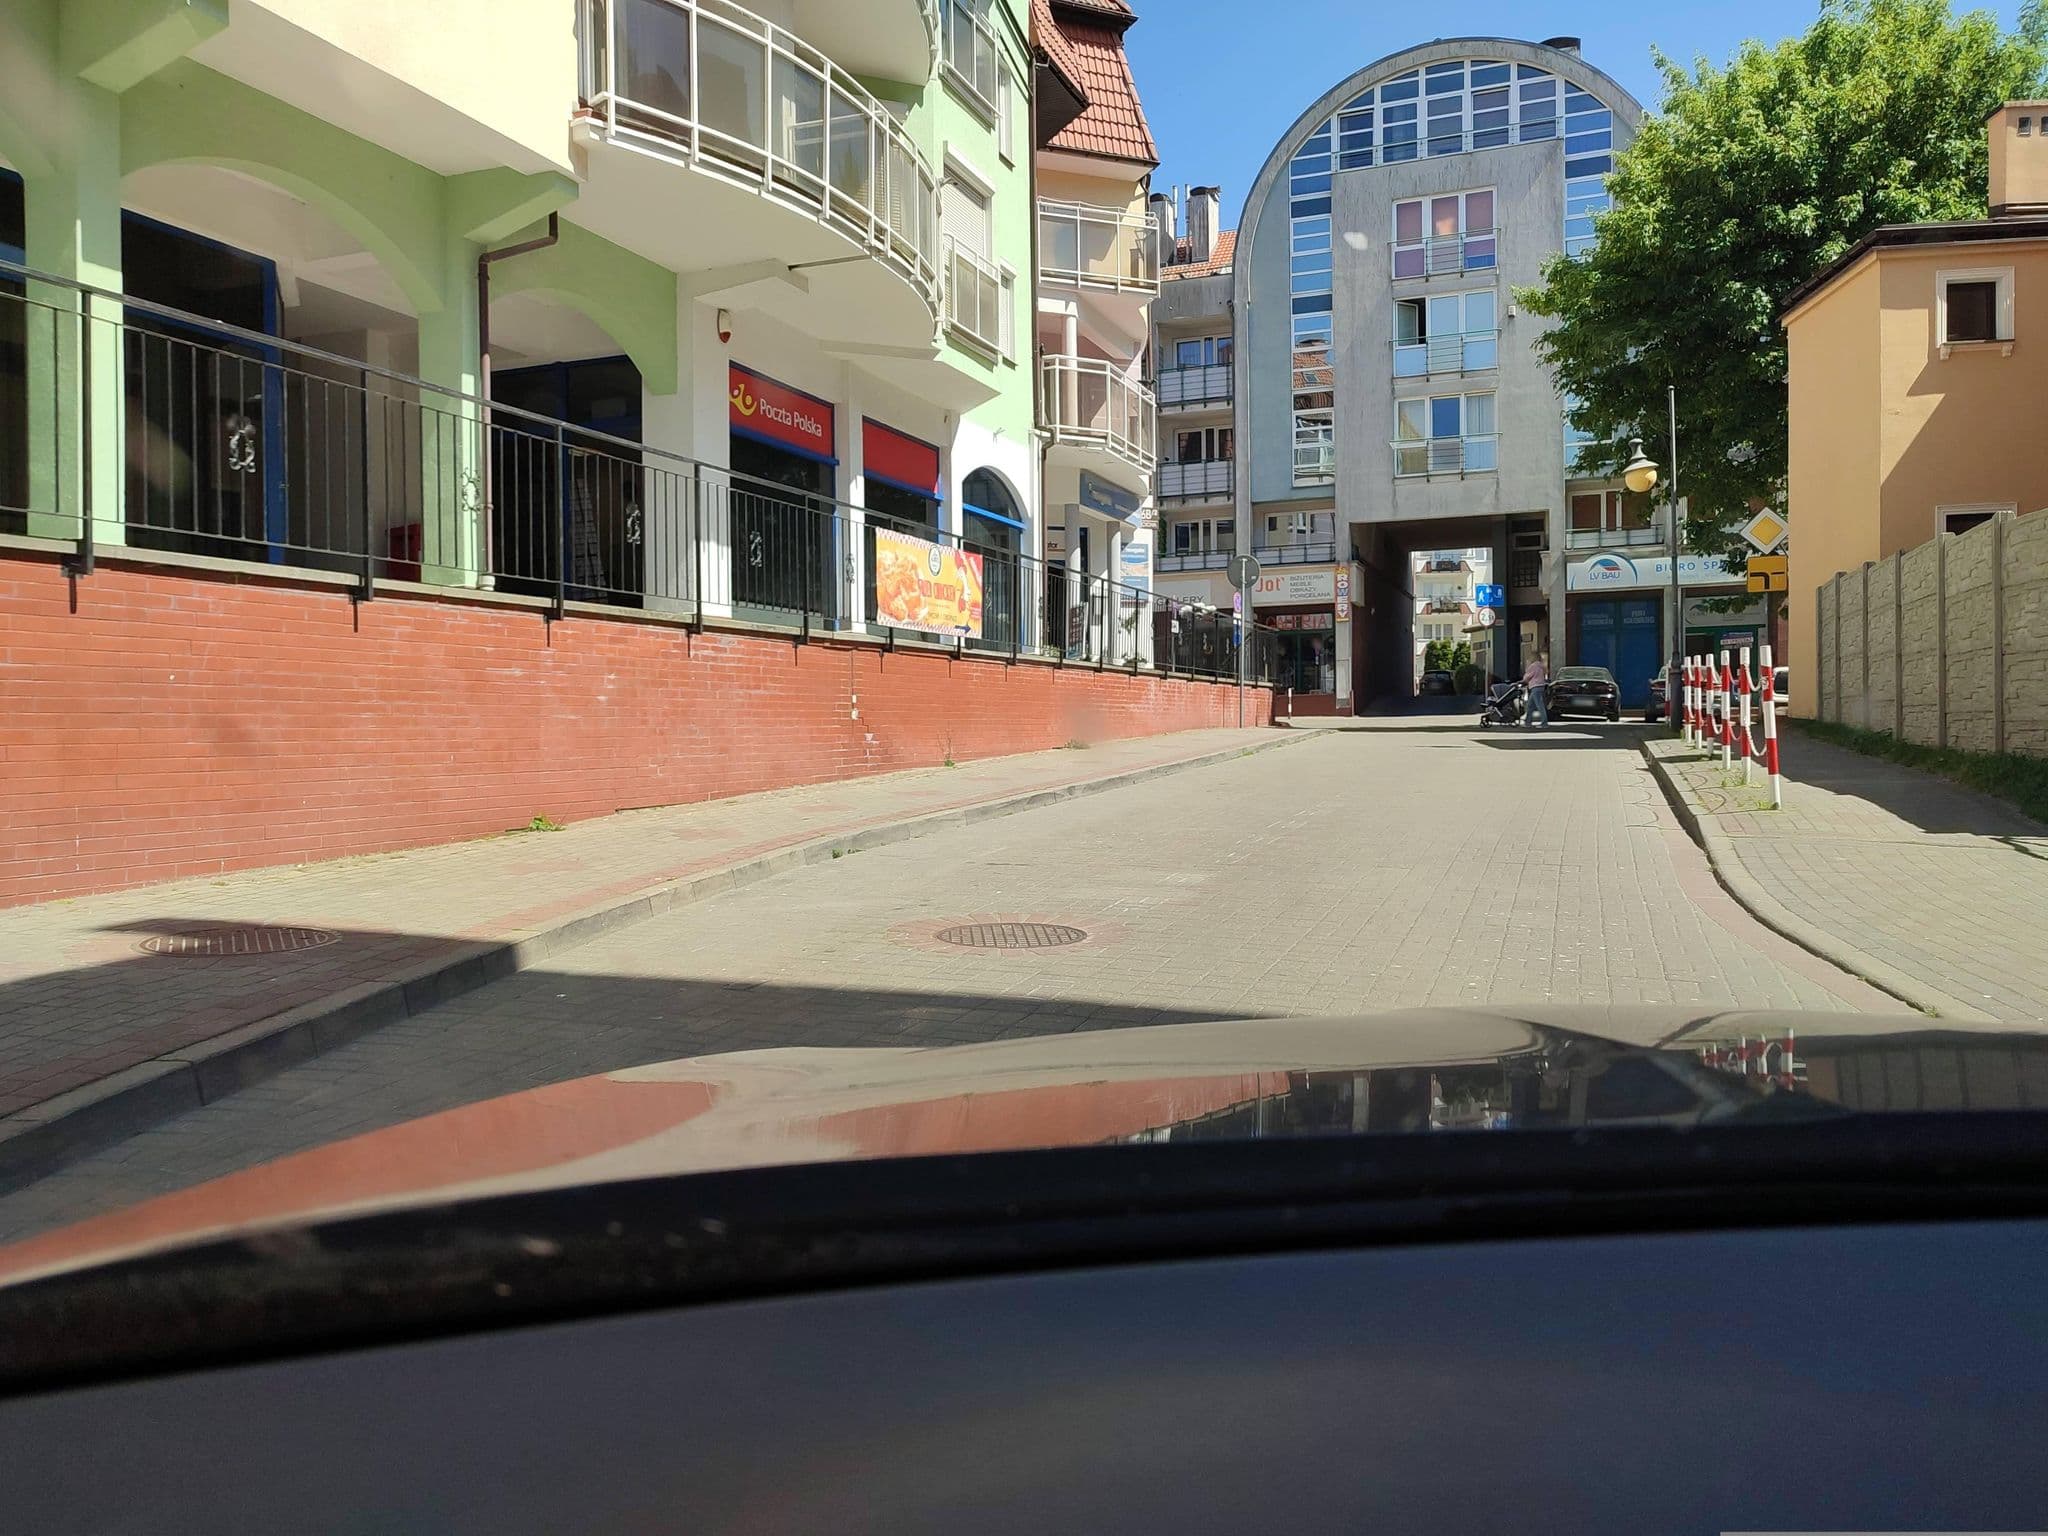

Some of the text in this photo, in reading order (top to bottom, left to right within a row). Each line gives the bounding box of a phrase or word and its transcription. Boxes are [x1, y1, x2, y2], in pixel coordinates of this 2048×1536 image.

[760, 398, 822, 438] Poczta Polska
[1336, 573, 1349, 618] ROWERY
[1601, 571, 1621, 580] BAU
